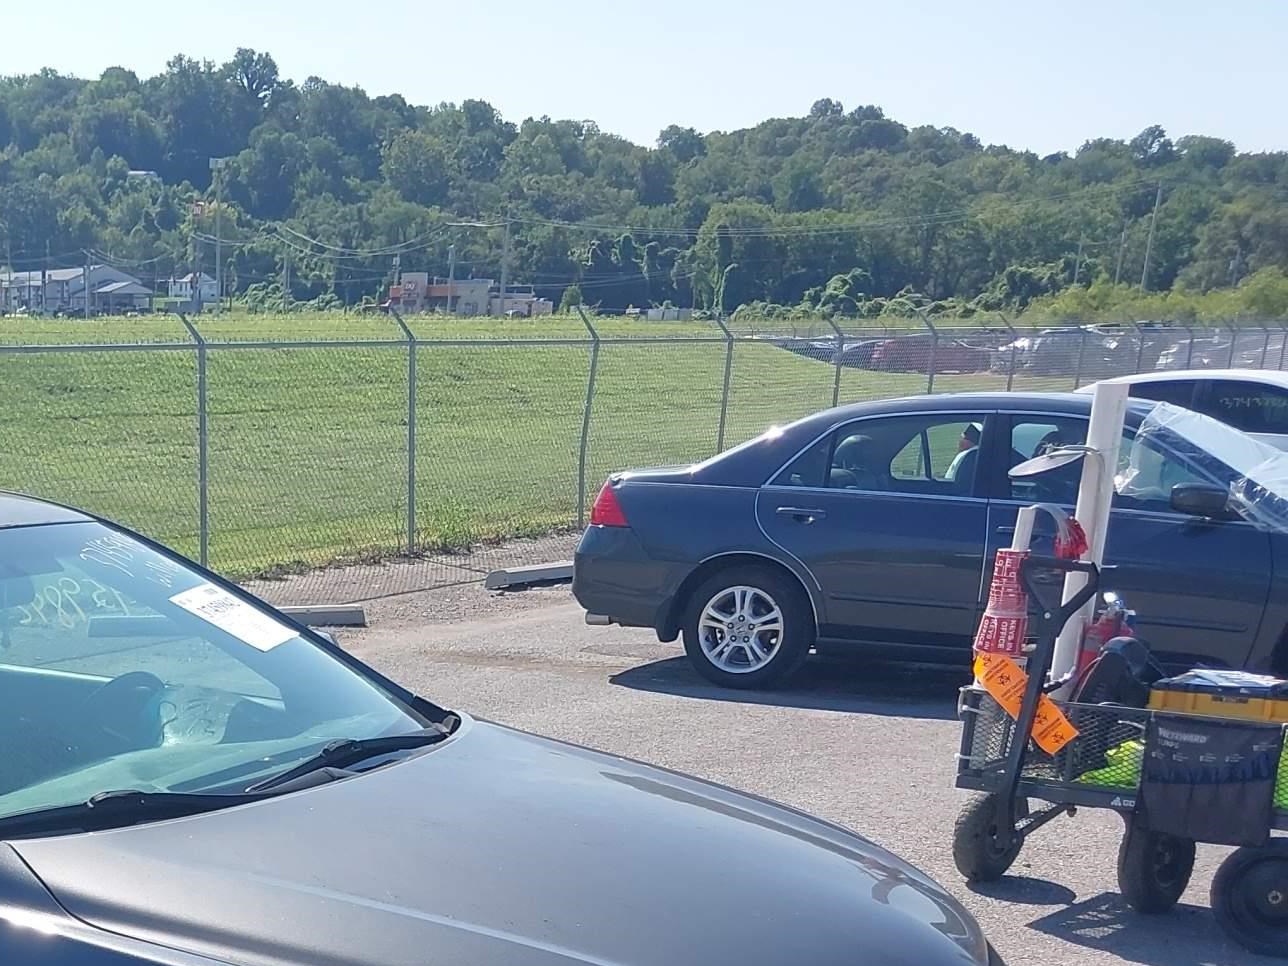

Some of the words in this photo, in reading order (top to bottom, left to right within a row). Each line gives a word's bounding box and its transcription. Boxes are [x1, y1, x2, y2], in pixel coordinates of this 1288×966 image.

[977, 618, 990, 647] OFFICE
[987, 618, 998, 639] KEYS
[997, 621, 1009, 649] OFFICE
[1008, 619, 1017, 639] KEYS
[983, 641, 991, 650] IN
[1006, 642, 1013, 651] IN
